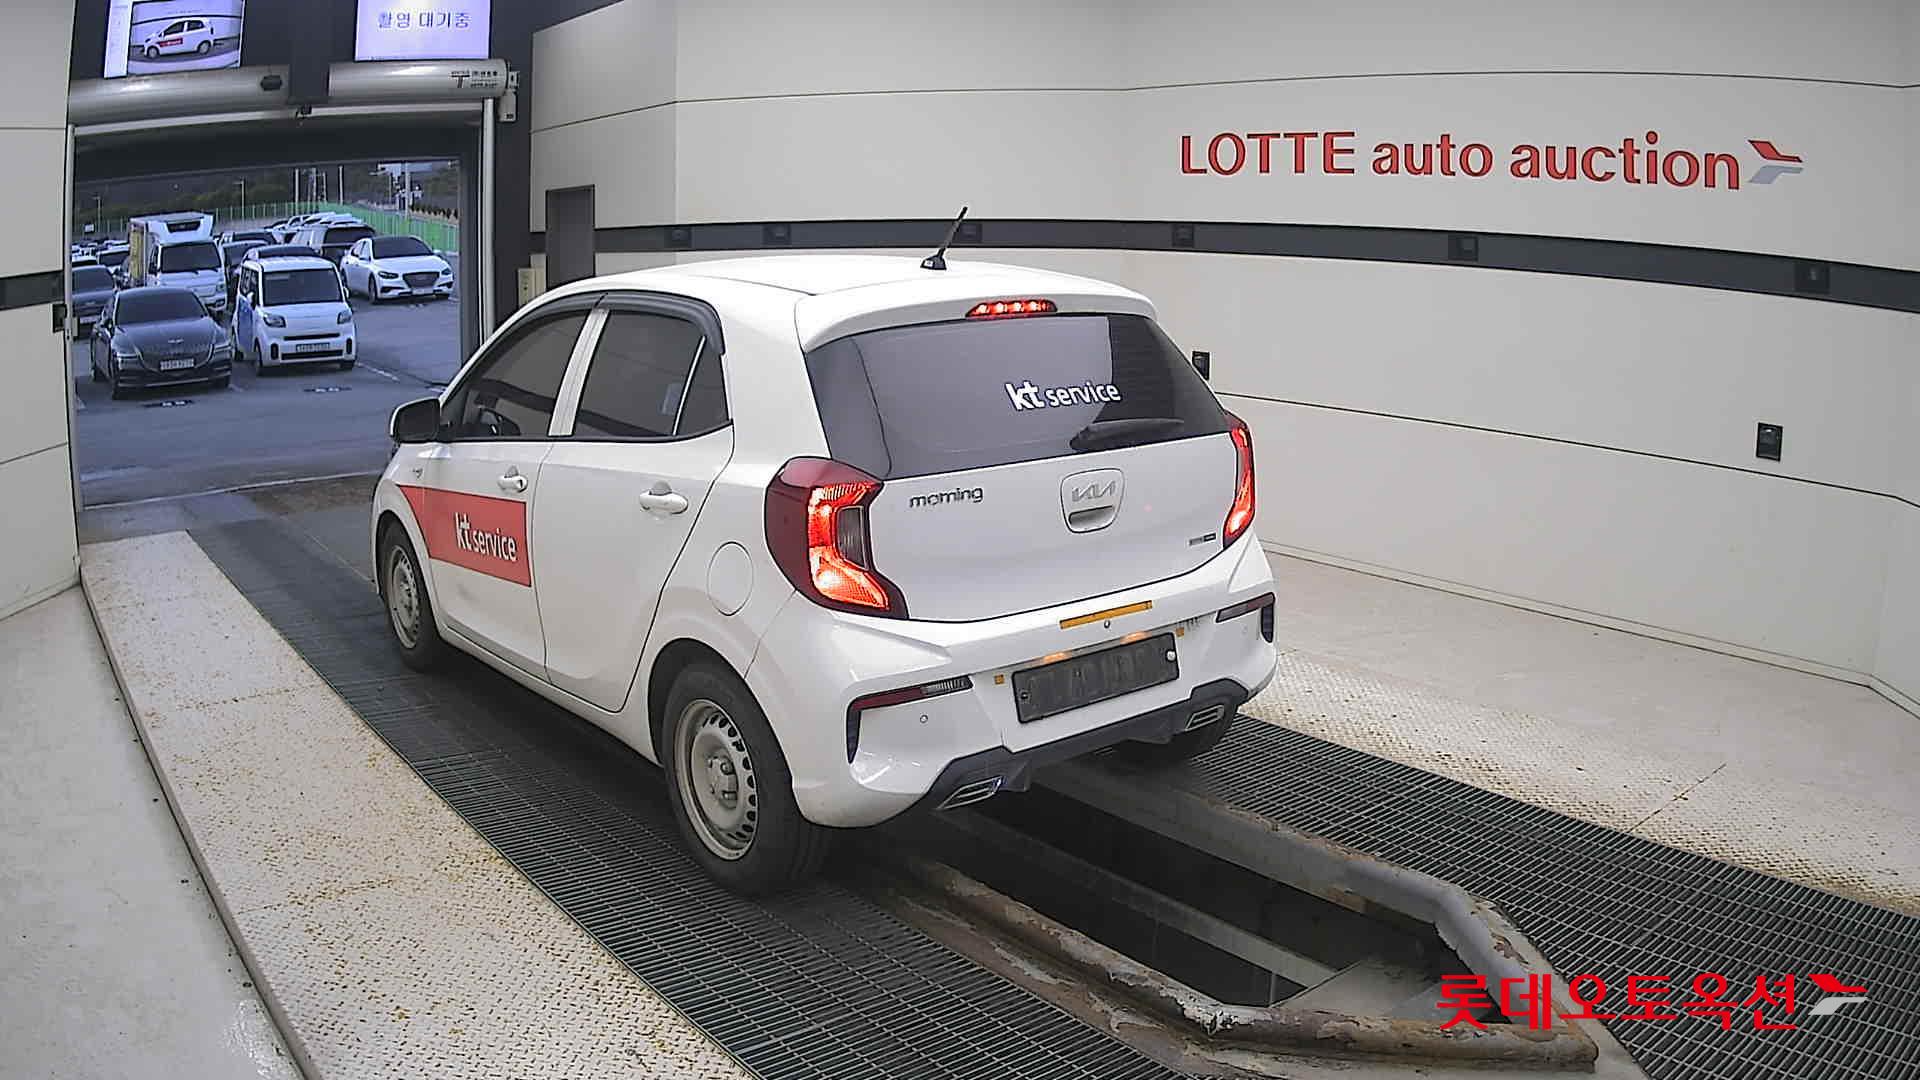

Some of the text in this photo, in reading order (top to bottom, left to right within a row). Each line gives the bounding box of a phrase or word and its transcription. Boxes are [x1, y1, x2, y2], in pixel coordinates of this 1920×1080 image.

[419, 11, 472, 29] 대기중
[1181, 130, 1740, 190] LOTTE auto auction
[1005, 381, 1122, 411] kt service
[909, 487, 984, 508] morning
[454, 511, 518, 562] kt service
